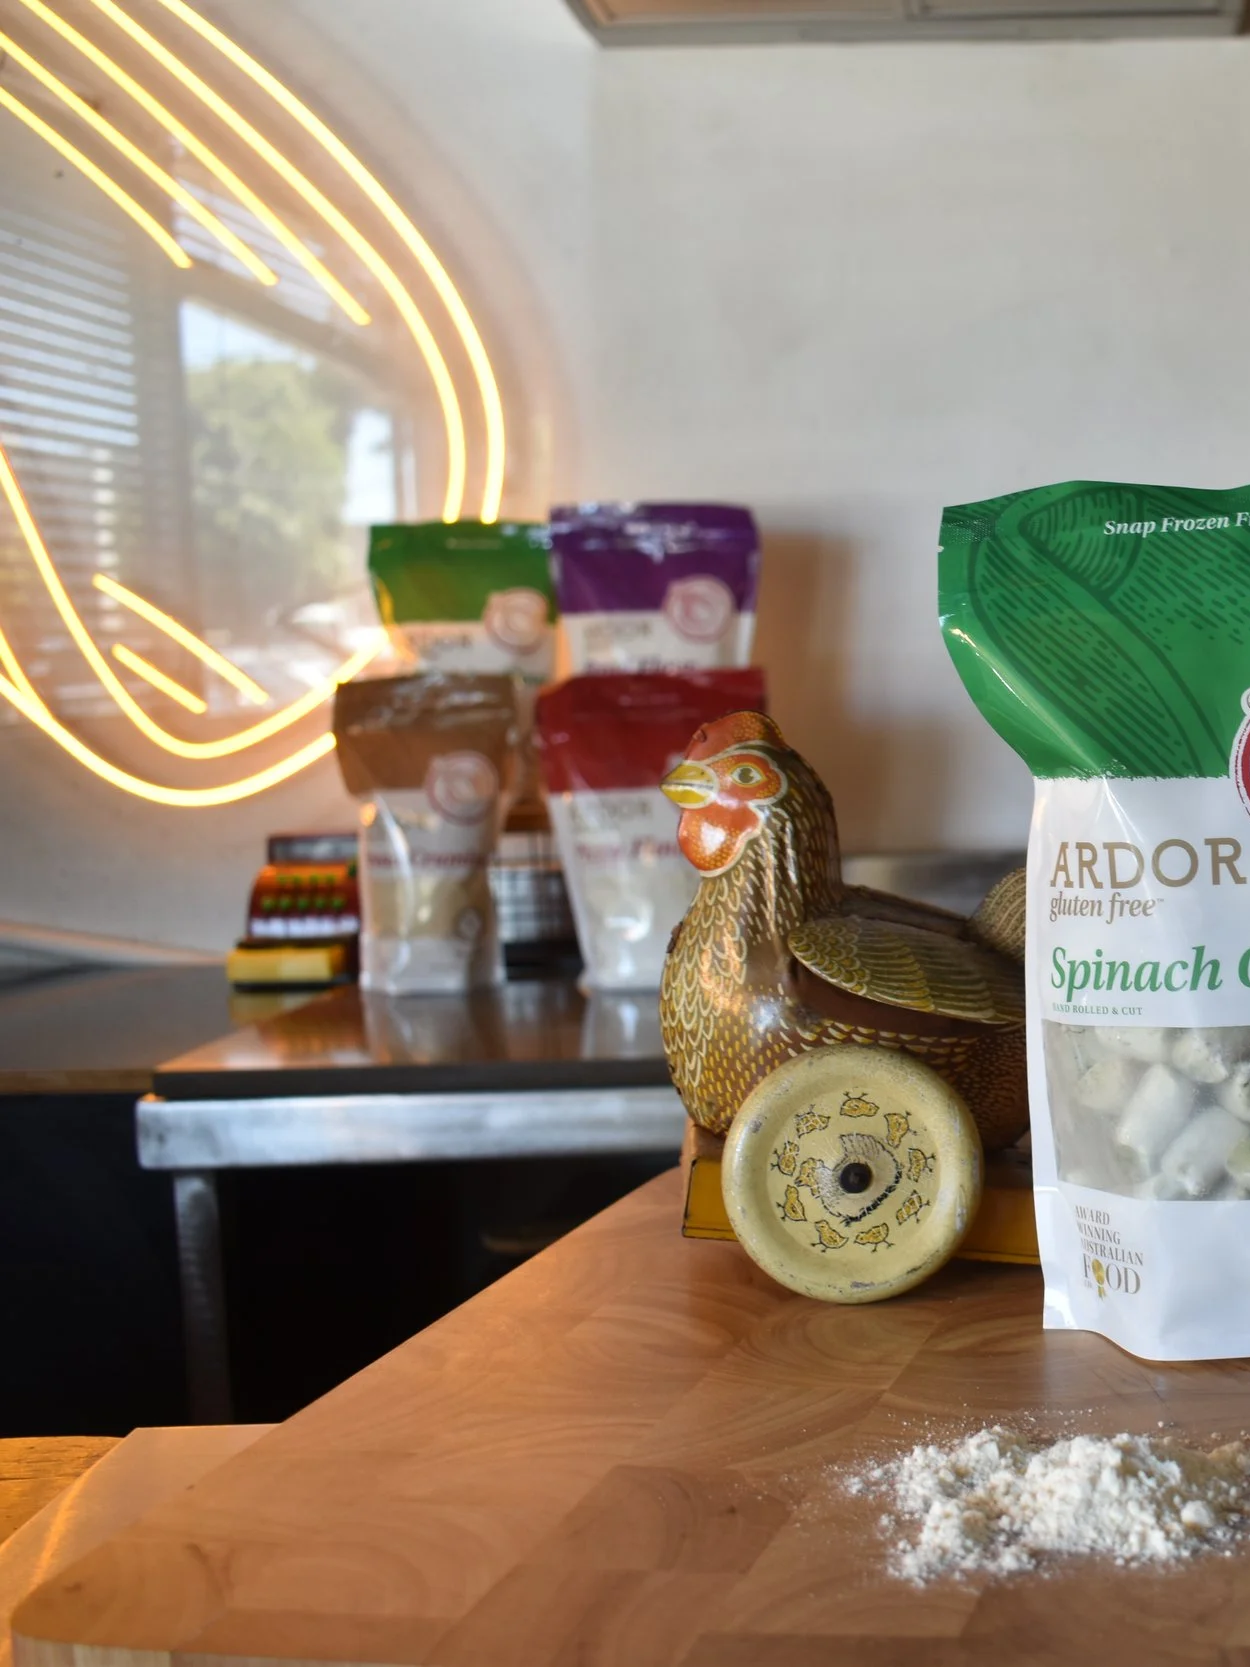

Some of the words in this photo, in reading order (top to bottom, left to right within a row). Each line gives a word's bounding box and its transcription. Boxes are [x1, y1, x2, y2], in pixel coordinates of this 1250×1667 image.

[1103, 520, 1156, 539] Snap
[1160, 515, 1230, 533] Frozen
[1050, 837, 1248, 889] ARDOR
[1049, 890, 1104, 923] gluten
[1051, 945, 1223, 1003] Spinach
[1072, 1004, 1109, 1015] ROLLED
[1111, 1006, 1119, 1015] &
[1121, 1006, 1143, 1016] CUT
[1074, 1204, 1111, 1226] AWARD
[1076, 1220, 1121, 1246] WINNING
